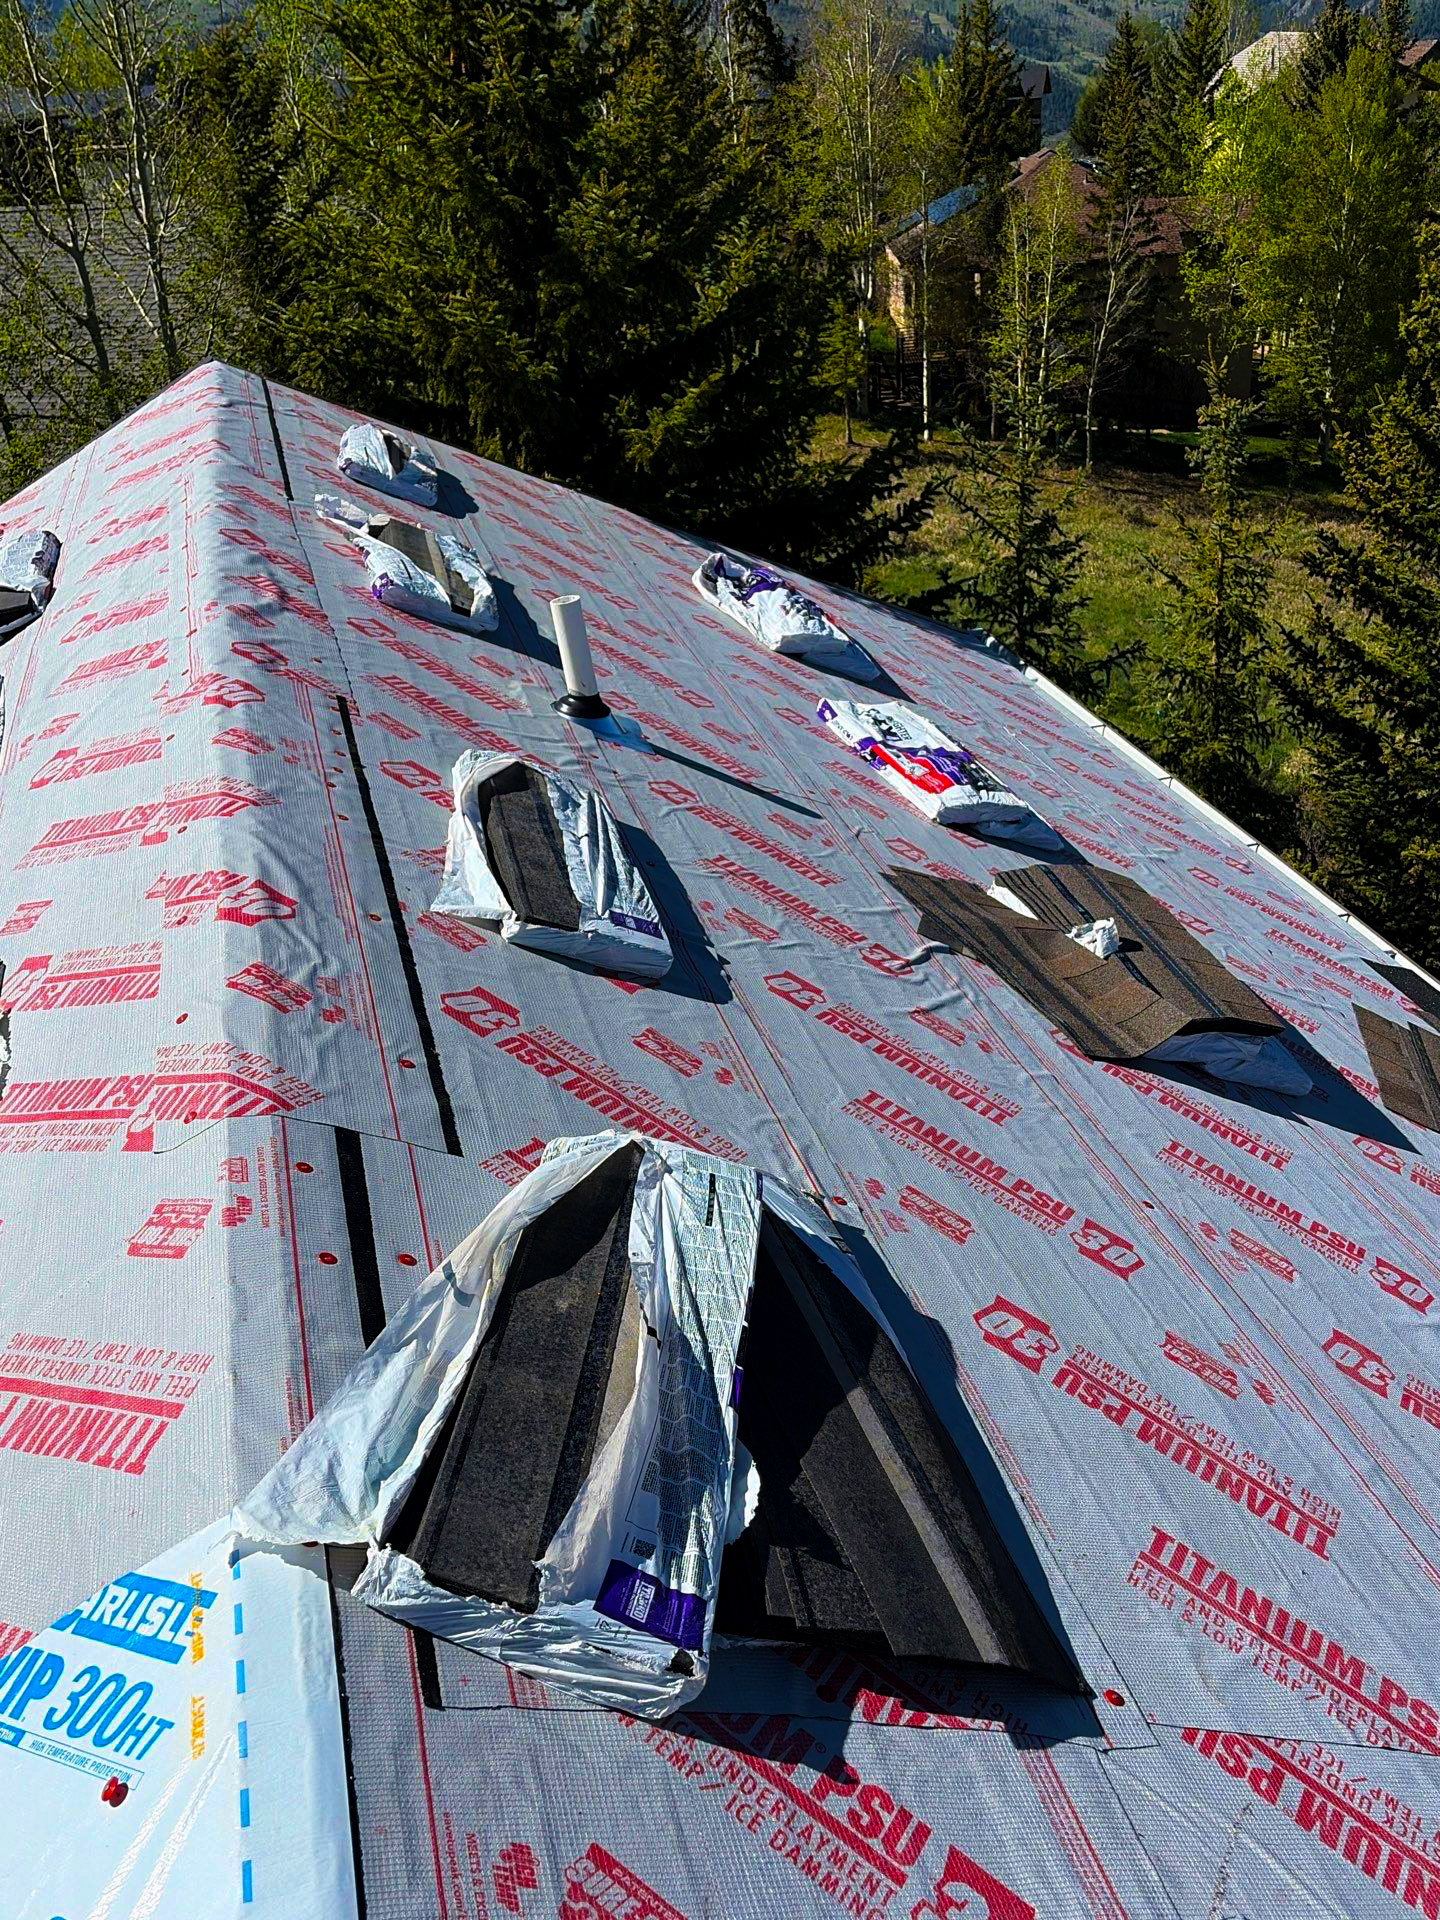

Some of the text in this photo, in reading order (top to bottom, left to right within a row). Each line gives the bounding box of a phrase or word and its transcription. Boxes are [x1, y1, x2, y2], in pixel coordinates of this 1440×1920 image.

[440, 986, 520, 1037] 30
[815, 1010, 873, 1044] PSU
[202, 1041, 236, 1055] TEMP
[235, 1051, 272, 1067] LOW
[495, 1036, 567, 1078] PSU
[536, 1024, 597, 1062] DAMMING
[236, 1065, 273, 1082] AND
[272, 1066, 286, 1075] &
[285, 1076, 324, 1101] HIGH
[599, 1061, 621, 1076] ICE
[872, 1043, 1008, 1127] TITANIUM
[1102, 1064, 1153, 1096] PSU
[274, 1081, 312, 1108] PEEL
[632, 1085, 665, 1108] TEMP
[667, 1106, 697, 1126] LOW
[673, 1120, 703, 1139] AND
[713, 1135, 748, 1161] HIGH
[1158, 1094, 1288, 1172] TITANIUM
[841, 1105, 873, 1126] HIGH
[890, 1134, 917, 1152] LOW
[967, 1181, 990, 1196] ICE
[993, 1197, 1057, 1237] DAMMING
[863, 1090, 1075, 1221] TITANIUM PSU
[880, 1122, 910, 1140] AND
[954, 1165, 1062, 1230] UNDERLAYMENT
[1352, 1136, 1406, 1175] 30
[1170, 1139, 1367, 1259] TITANIUM PSU
[1069, 1218, 1145, 1280] 30
[1300, 1238, 1359, 1275] DAMMING
[1370, 1257, 1435, 1314] 30
[7, 1332, 214, 1374] HIGH & LOW TEMP ICE DAMMING
[972, 1298, 1061, 1371] 30
[0, 1353, 200, 1398] PEEL AND STICK UNDERLAYMEN
[1075, 1344, 1149, 1394] DAMMING
[1322, 1328, 1395, 1399] 30
[1073, 1353, 1199, 1438] UNDERLAYMENT
[1154, 1391, 1178, 1414] ICE
[0, 1398, 169, 1476] TITANIUM
[1195, 1421, 1237, 1449] TEMP
[1203, 1436, 1250, 1471] STICK
[1051, 1362, 1335, 1561] TITANIUM PSU
[1243, 1450, 1274, 1475] LOW
[1257, 1469, 1293, 1495] AND
[1132, 1560, 1290, 1668] PEEL AND STICK
[1126, 1572, 1173, 1610] HIGH
[1202, 1624, 1243, 1655] LOW
[1252, 1654, 1304, 1692] TEMP
[1327, 1703, 1356, 1733] ICE
[43, 1665, 175, 1761] 300HT
[1377, 1676, 1440, 1739] PS
[28, 1739, 133, 1782] HIGH TEMPERATURE PROTECTION
[644, 1726, 706, 1781] TEMP
[723, 1793, 767, 1834] ICE
[1313, 1743, 1422, 1832] TEMP ICE
[708, 1747, 898, 1907] UNDERLAYMENT
[811, 1756, 933, 1867] PSU
[465, 1833, 481, 1874] MEETS
